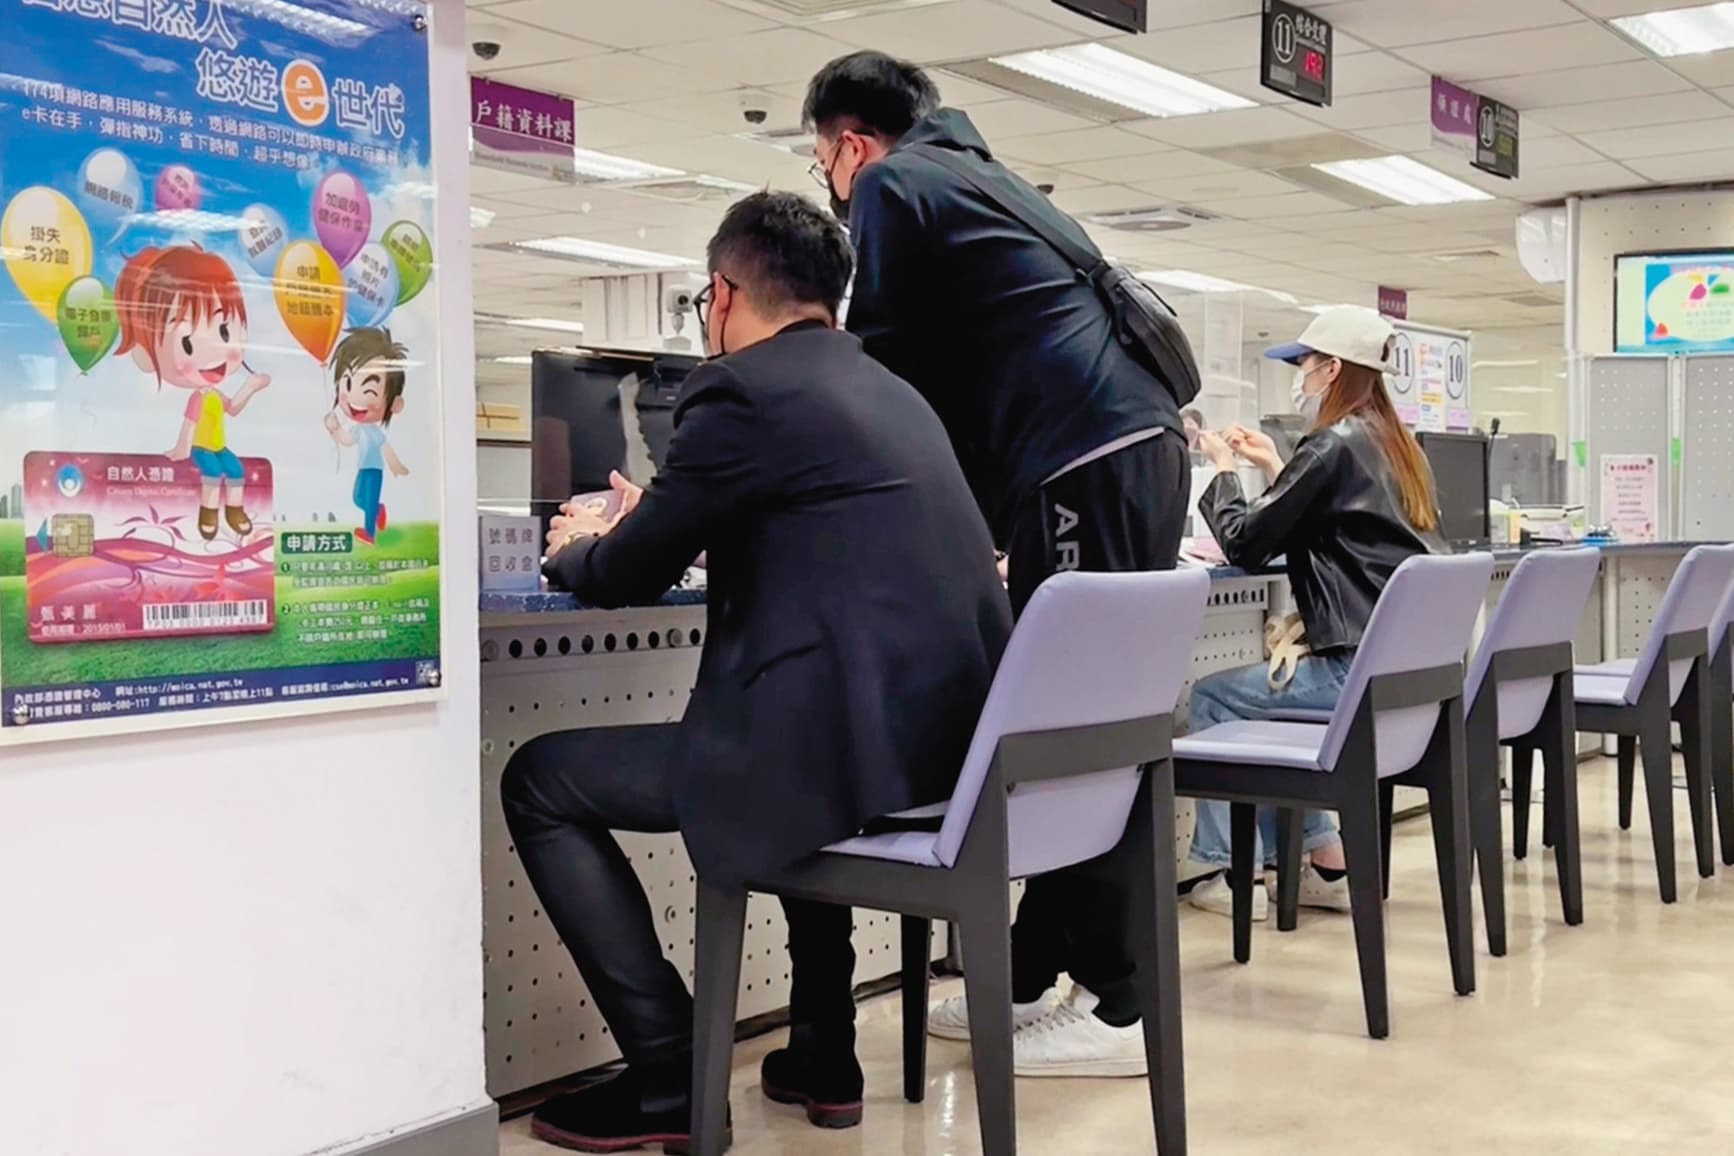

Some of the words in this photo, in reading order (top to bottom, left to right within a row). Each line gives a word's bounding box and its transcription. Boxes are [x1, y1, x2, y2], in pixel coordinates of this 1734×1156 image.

[22, 0, 238, 49] 自然人
[1276, 20, 1291, 54] 11
[196, 48, 405, 138] 悠遊e世代
[475, 99, 572, 143] 戶籍資料課
[31, 226, 61, 244] 掛失
[1449, 354, 1463, 384] 10
[107, 466, 174, 482] 自然人憑證
[287, 533, 346, 552] 申請方式
[489, 527, 533, 544] 號碼牌
